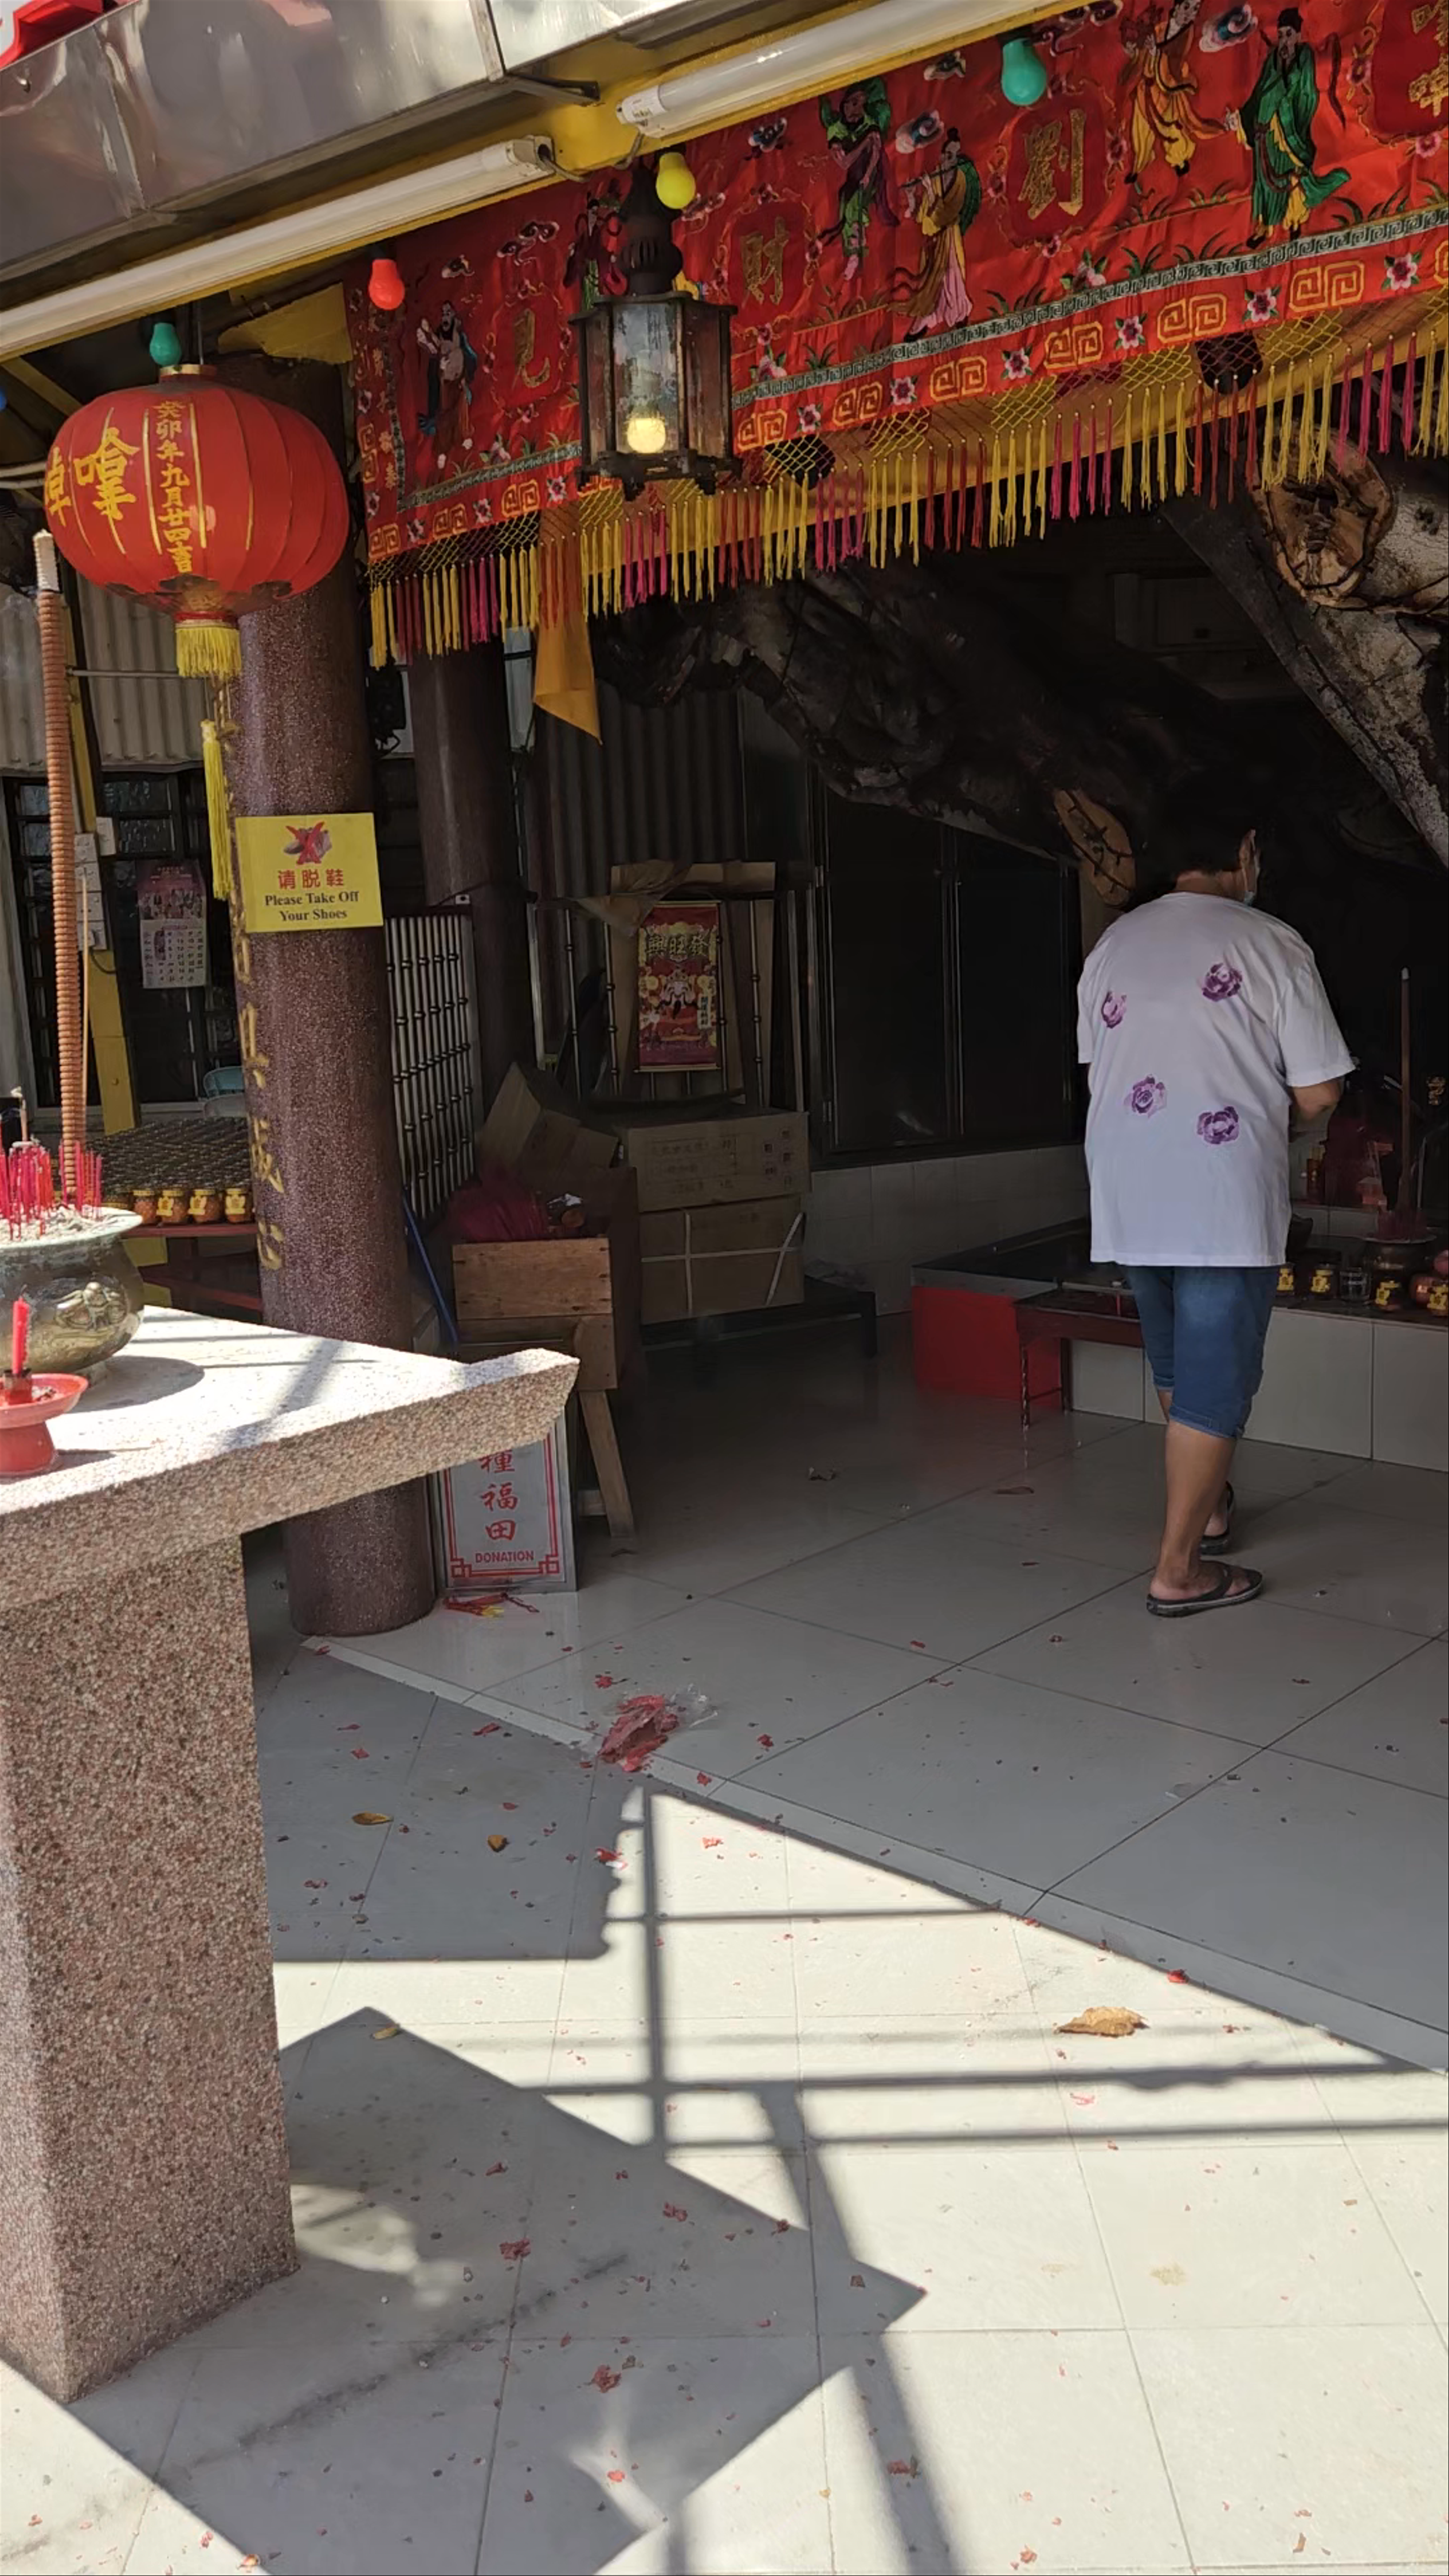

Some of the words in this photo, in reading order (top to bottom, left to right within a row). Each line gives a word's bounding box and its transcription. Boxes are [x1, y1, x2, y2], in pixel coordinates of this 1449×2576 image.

[278, 869, 344, 890] 请脱鞋
[265, 894, 302, 906] Please
[305, 892, 335, 903] Take
[338, 891, 359, 902] Off
[280, 910, 309, 922] Your
[313, 908, 347, 920] Shoes
[475, 1550, 534, 1563] DONATION
